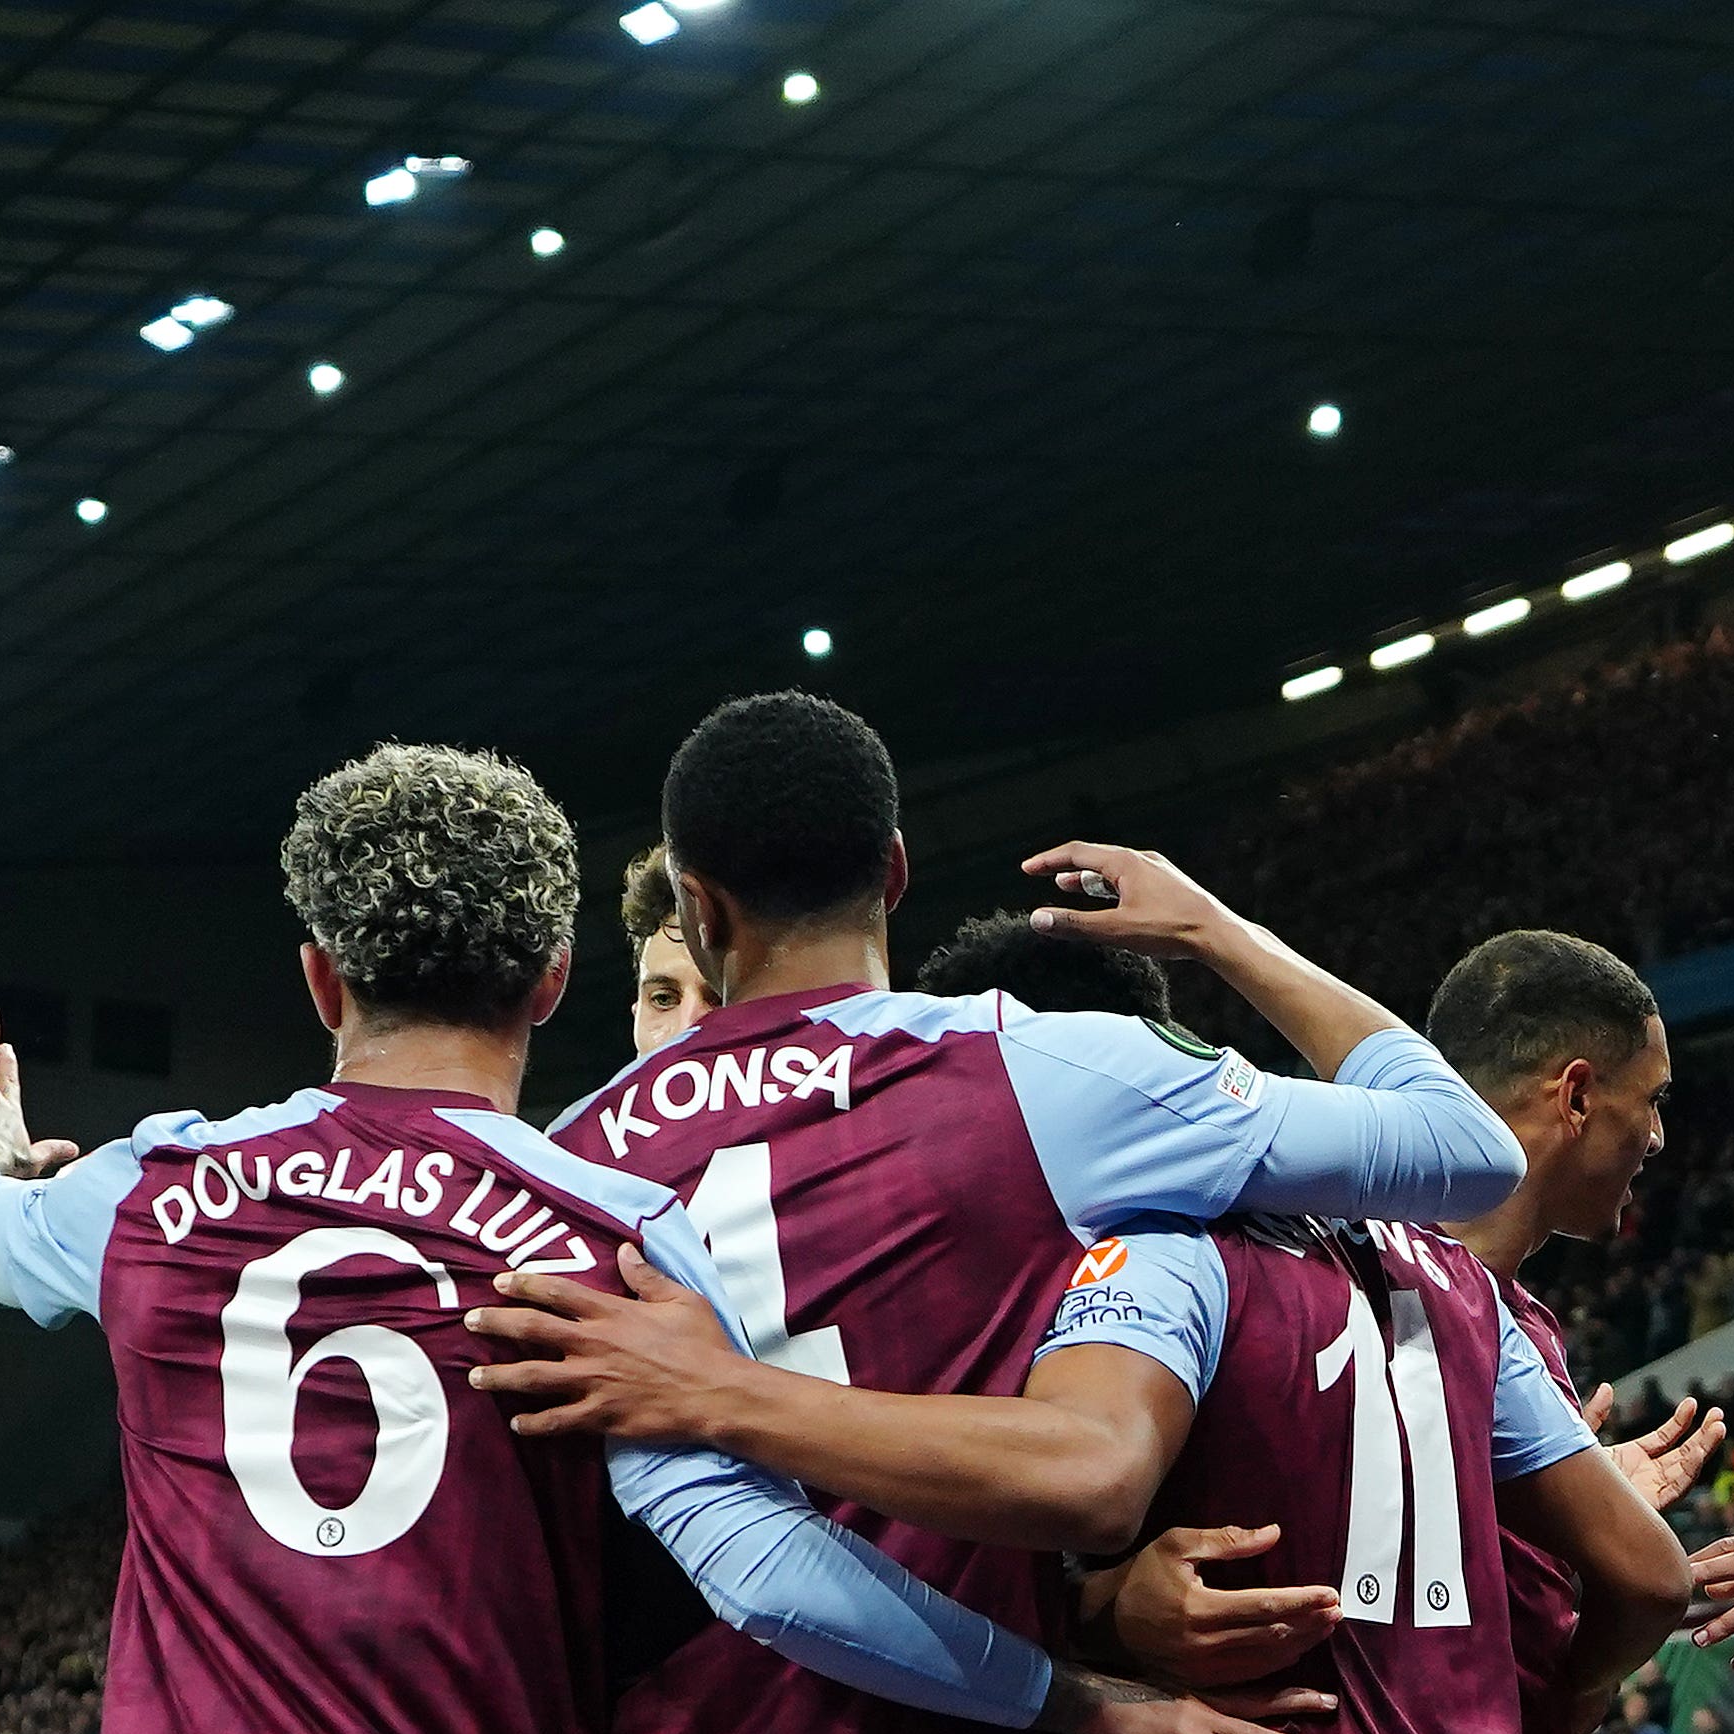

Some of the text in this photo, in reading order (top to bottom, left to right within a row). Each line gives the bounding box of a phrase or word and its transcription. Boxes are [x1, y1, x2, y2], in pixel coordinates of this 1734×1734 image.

[151, 1147, 598, 1275] DOUGLAS LUIZ
[598, 1045, 854, 1159] KONSA
[221, 1227, 460, 1557] 6
[1315, 1284, 1472, 1627] 11
